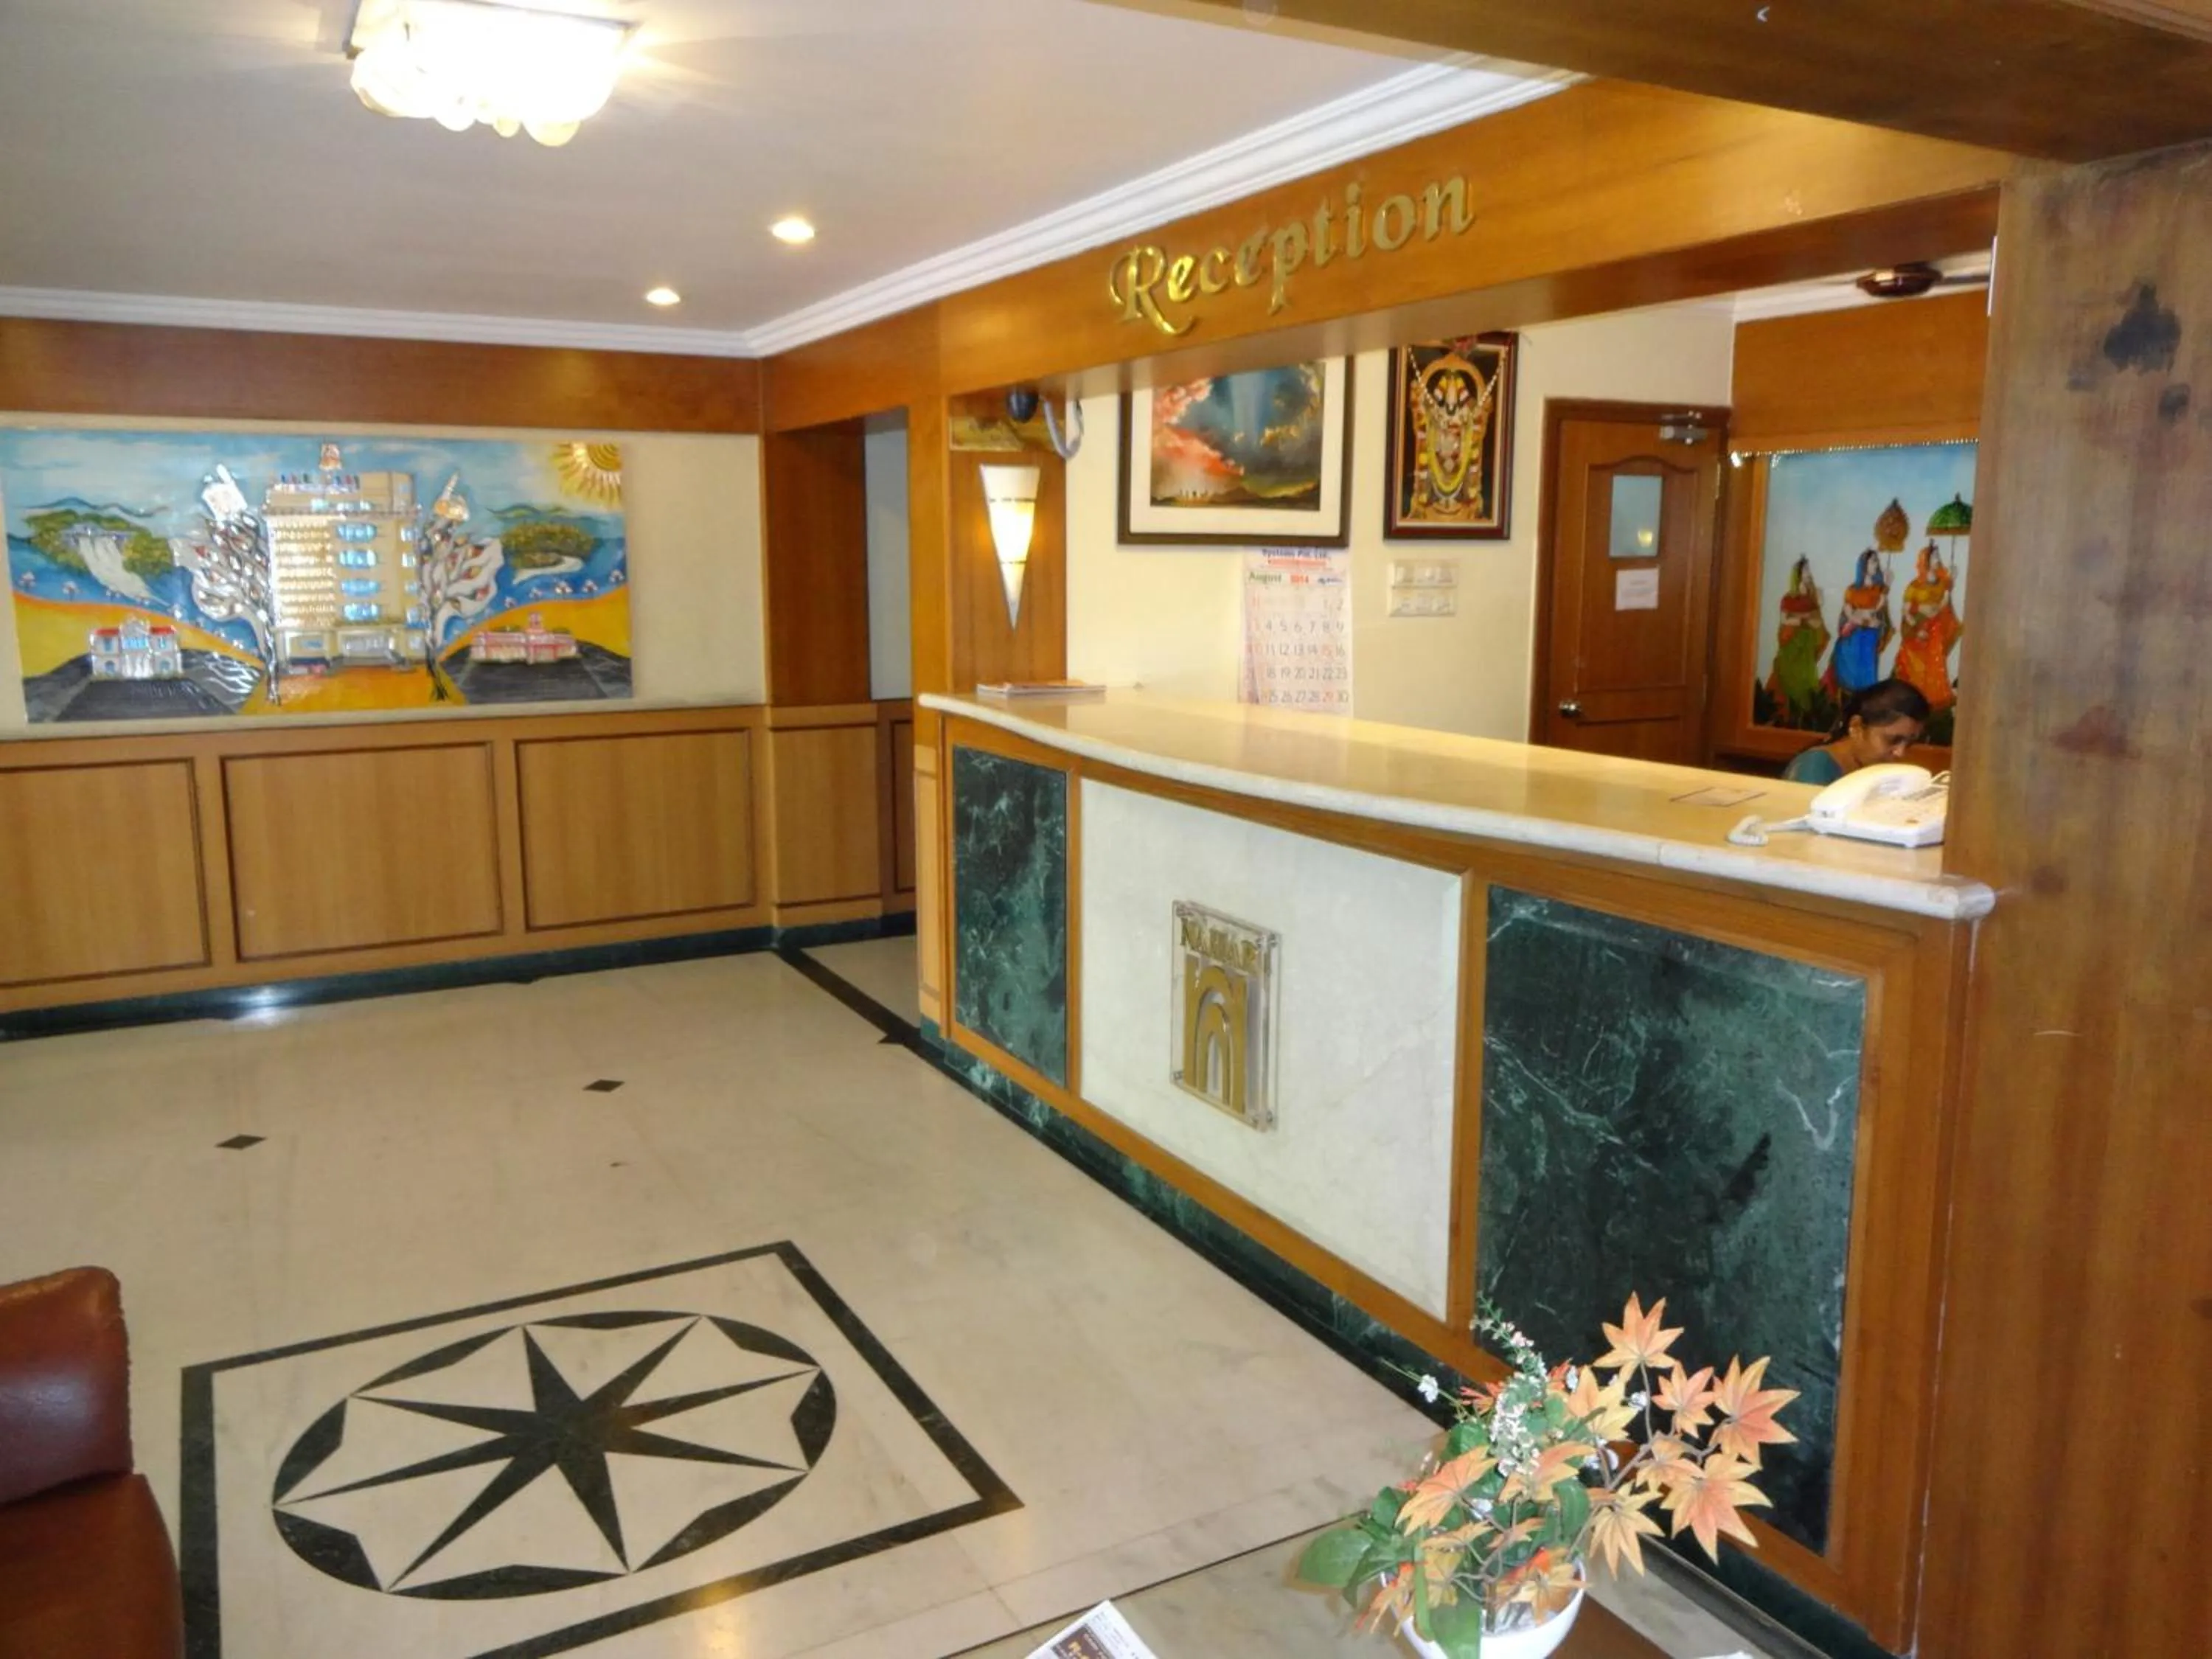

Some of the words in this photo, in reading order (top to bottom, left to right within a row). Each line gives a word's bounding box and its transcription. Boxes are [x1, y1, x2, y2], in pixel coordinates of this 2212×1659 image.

[1110, 175, 1474, 335] Reception
[1248, 572, 1281, 585] August
[1279, 620, 1287, 631] 5
[1294, 622, 1302, 633] 6
[1279, 643, 1290, 656] 12
[1294, 643, 1304, 656] 13
